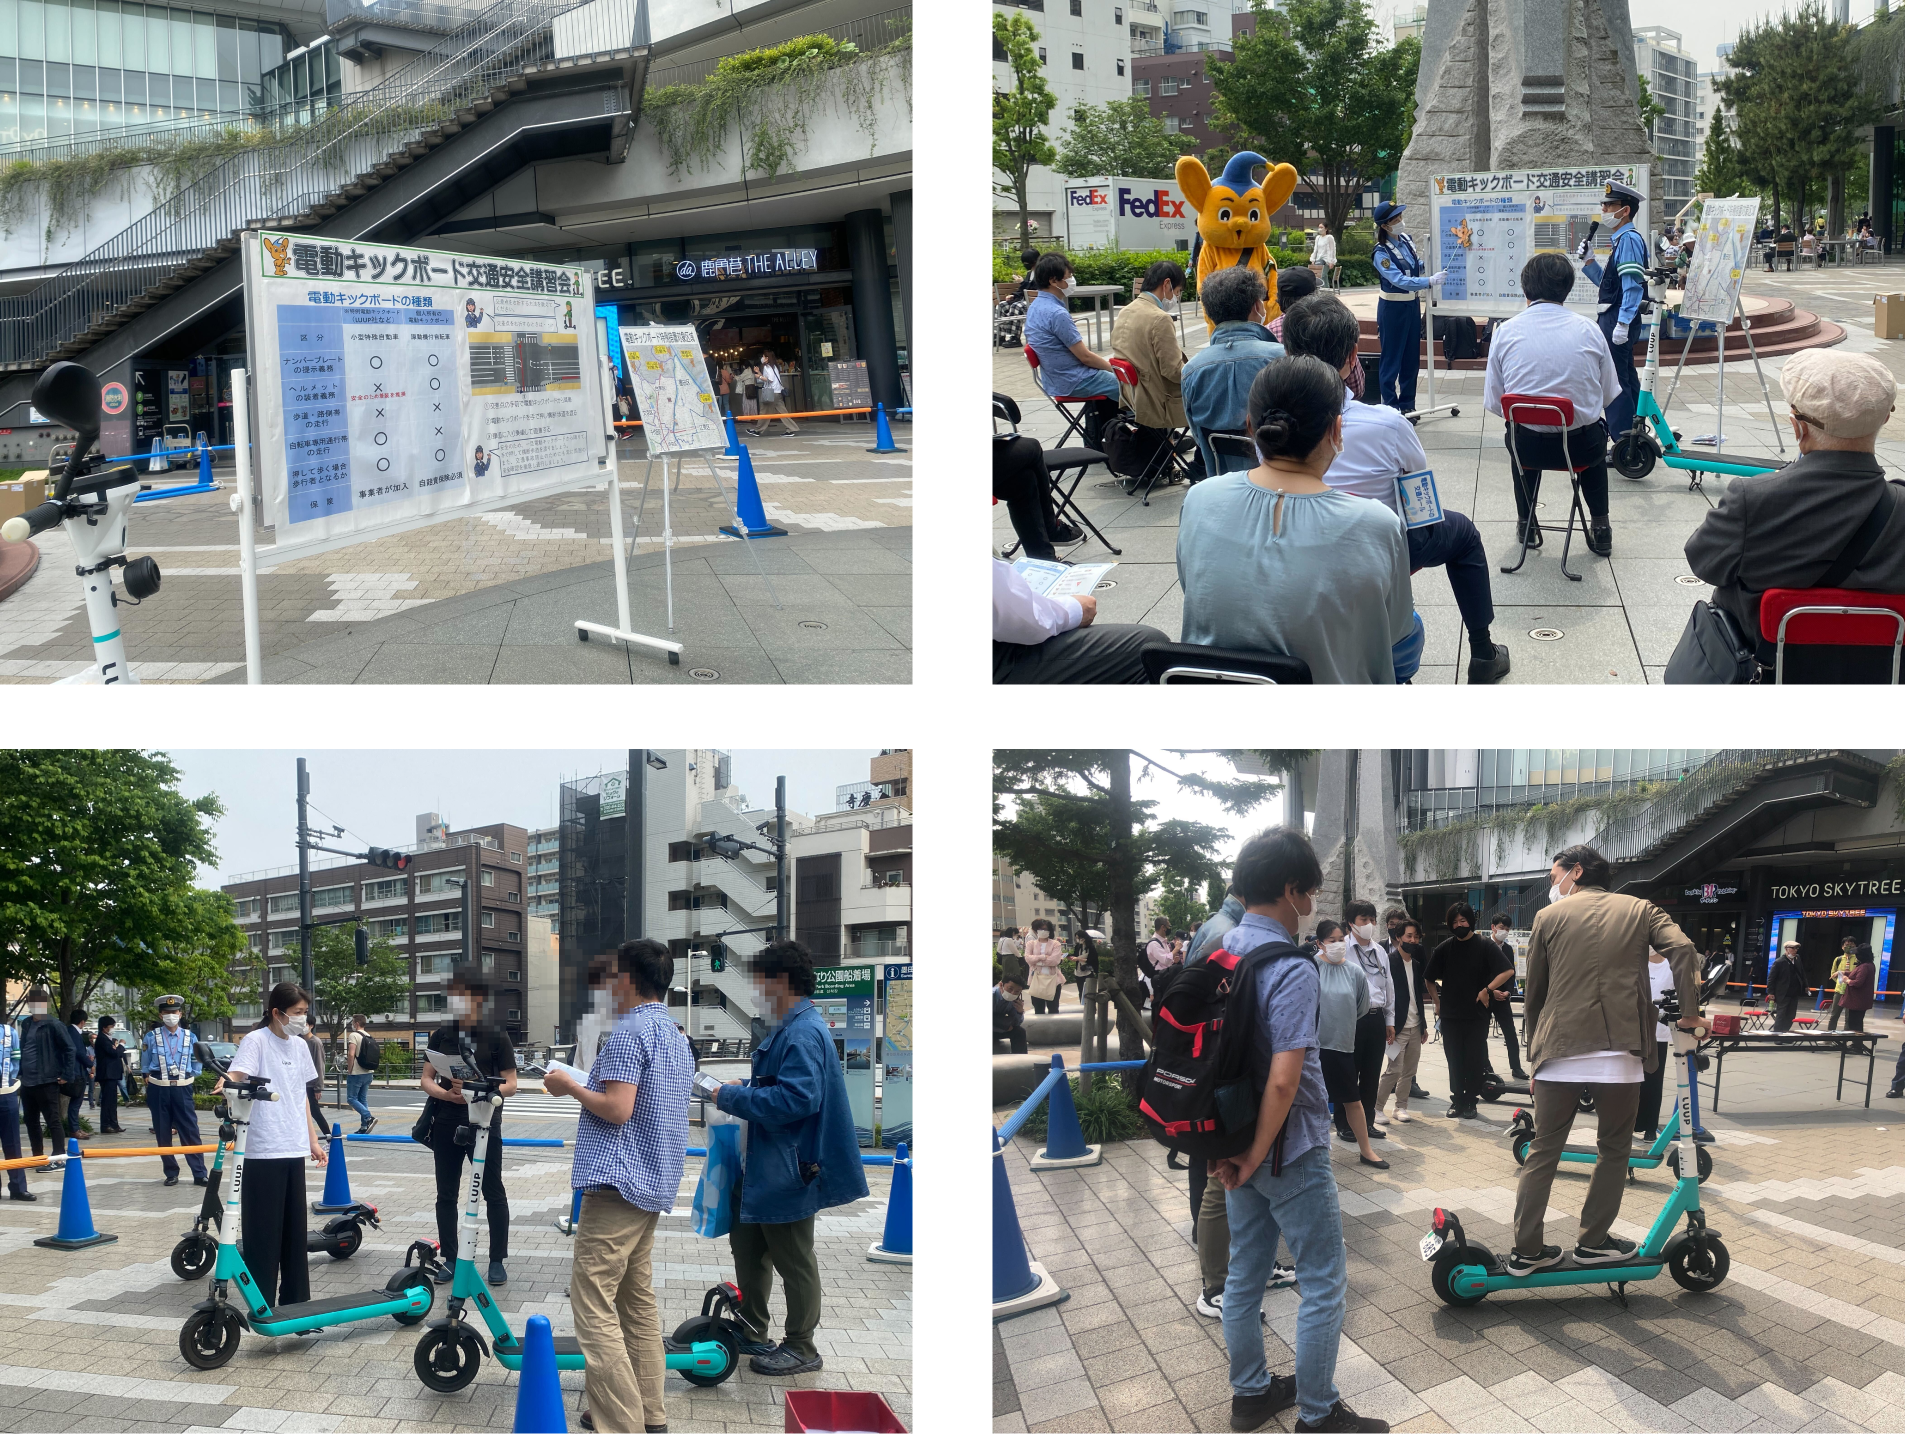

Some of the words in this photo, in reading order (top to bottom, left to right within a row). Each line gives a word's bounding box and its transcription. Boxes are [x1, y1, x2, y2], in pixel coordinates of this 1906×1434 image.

[1070, 188, 1108, 206] FedEx
[1118, 187, 1186, 219] FedEx
[1451, 197, 1513, 206] 電動キックボードの種類
[1160, 220, 1185, 230] Express
[292, 243, 571, 295] 電動キックボード交通安全講習会
[701, 257, 742, 277] 鹿角巷
[745, 254, 772, 274] THE
[775, 250, 818, 271] ALLEY
[308, 291, 433, 308] 電動キックボードの種類
[350, 333, 399, 341] 小型特殊自動車
[1648, 332, 1656, 353] LUUP
[283, 356, 343, 365] ナンバープレート
[293, 364, 334, 374] の提示義務
[296, 391, 336, 402] の装着義務
[293, 409, 341, 421] 歩道・路側帯
[305, 419, 329, 428] の走行
[289, 435, 348, 450] 自転車専用通行帯
[306, 447, 330, 457] の走行
[292, 463, 347, 478] 押して歩く場合
[292, 472, 348, 489] 歩行者となるか
[419, 471, 463, 488] 自賠責保険必須
[358, 482, 409, 499] 事業者が加入
[1420, 476, 1435, 517] 電動キックボードの
[1413, 485, 1426, 513] 交通ルール
[1771, 883, 1820, 899] TOKYO
[1801, 910, 1828, 918] TOKYO
[1828, 909, 1866, 917] SKYTREE
[1153, 1076, 1183, 1090] MOTORSPORT
[1682, 1096, 1691, 1125] LUUP
[233, 1164, 243, 1193] LUUP
[470, 1172, 481, 1203] LUUP
